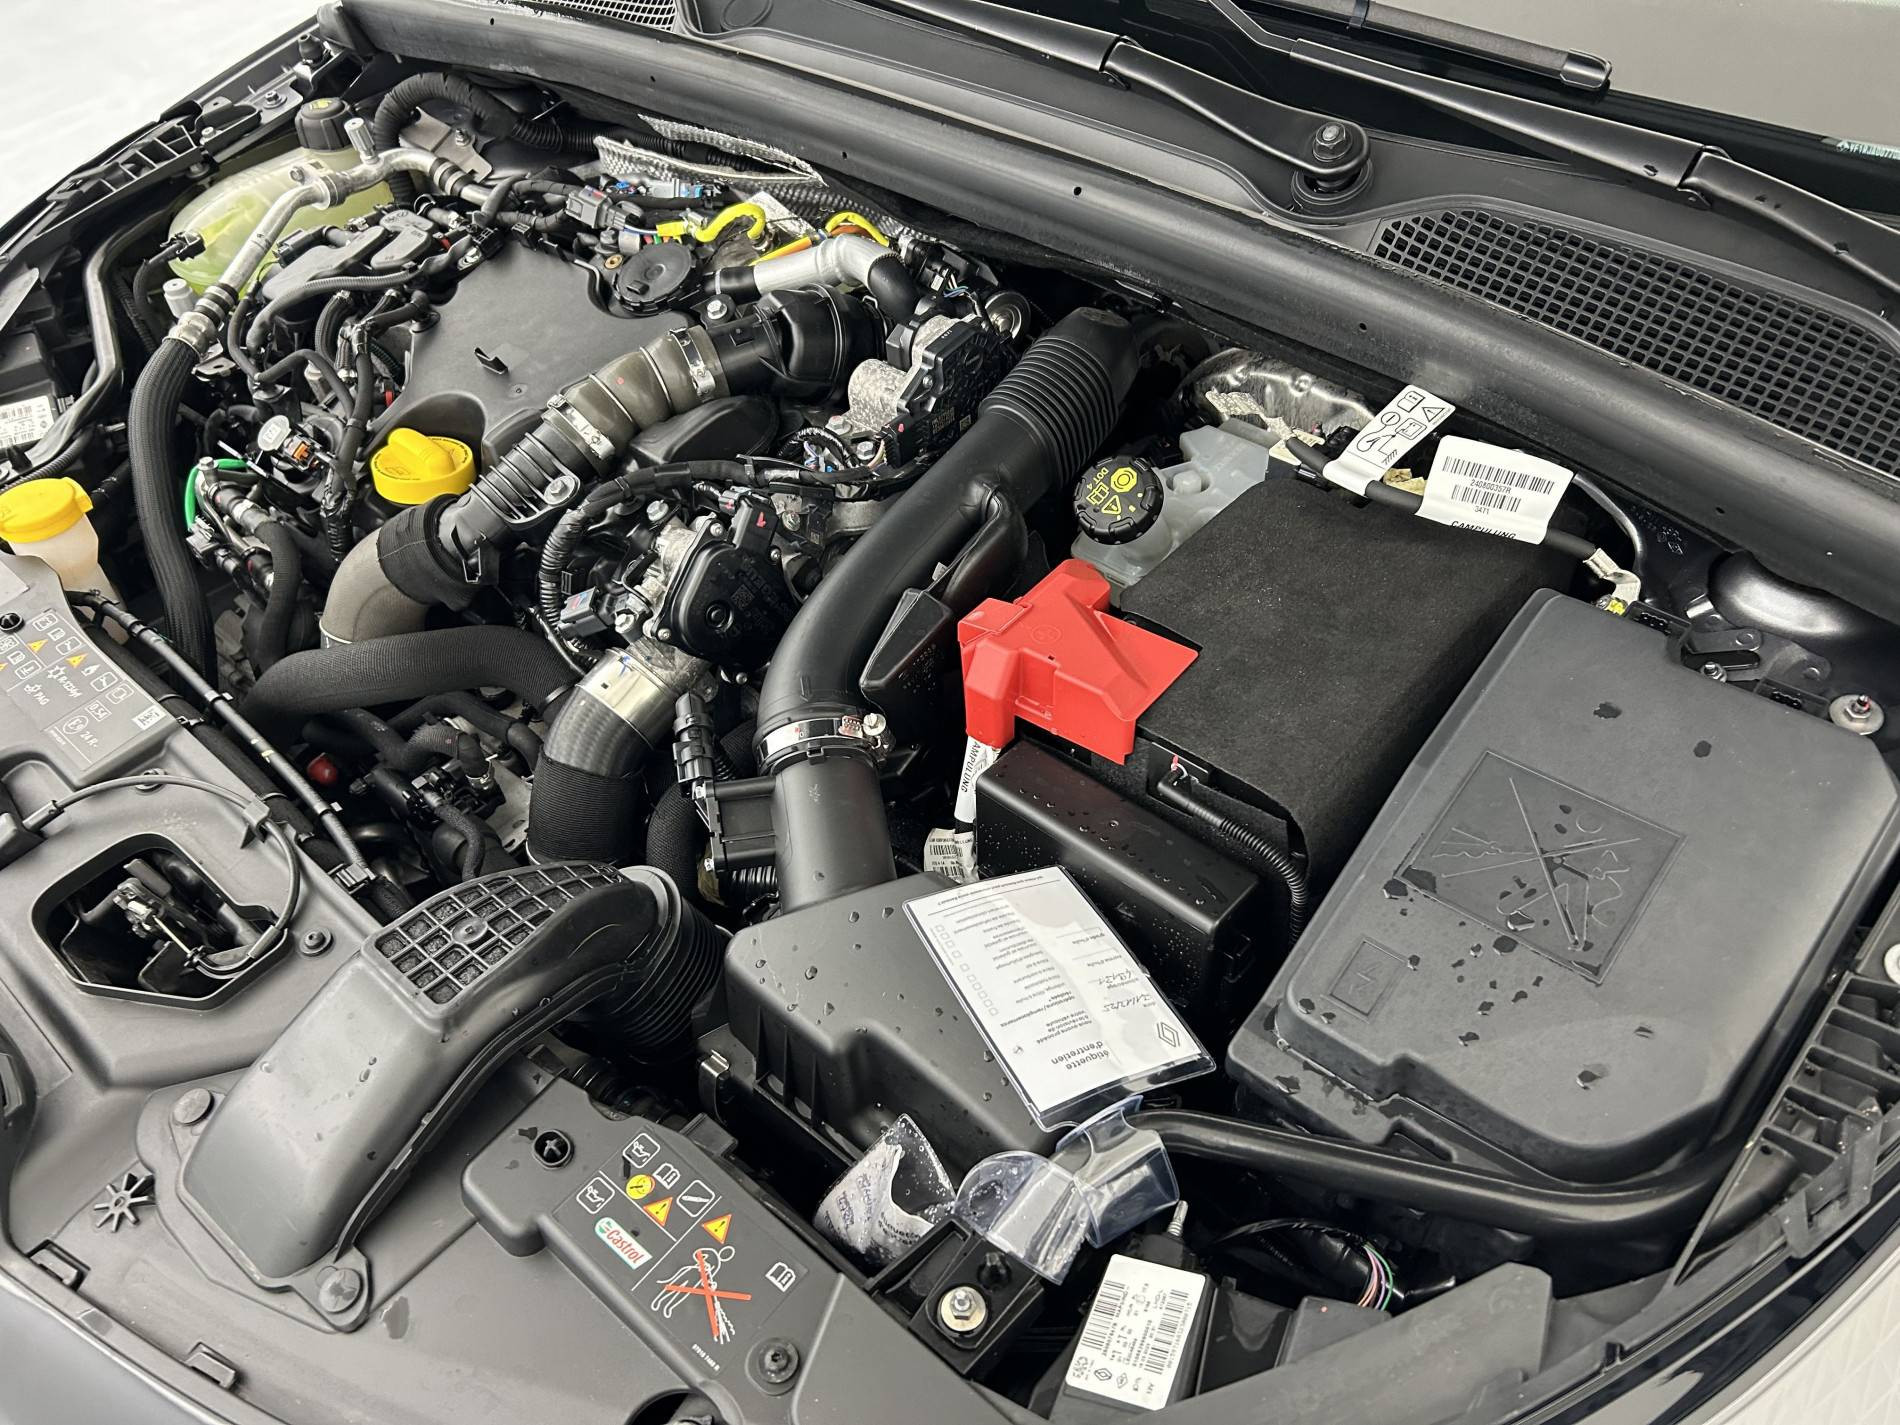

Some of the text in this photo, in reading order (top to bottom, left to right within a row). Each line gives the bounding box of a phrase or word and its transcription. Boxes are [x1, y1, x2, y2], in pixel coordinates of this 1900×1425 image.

[1093, 467, 1109, 484] DOT
[960, 741, 981, 793] AMPULUNG
[1051, 1041, 1104, 1065] d'entretien
[1065, 1050, 1110, 1070] étiquette
[603, 1228, 645, 1265] Castrol
